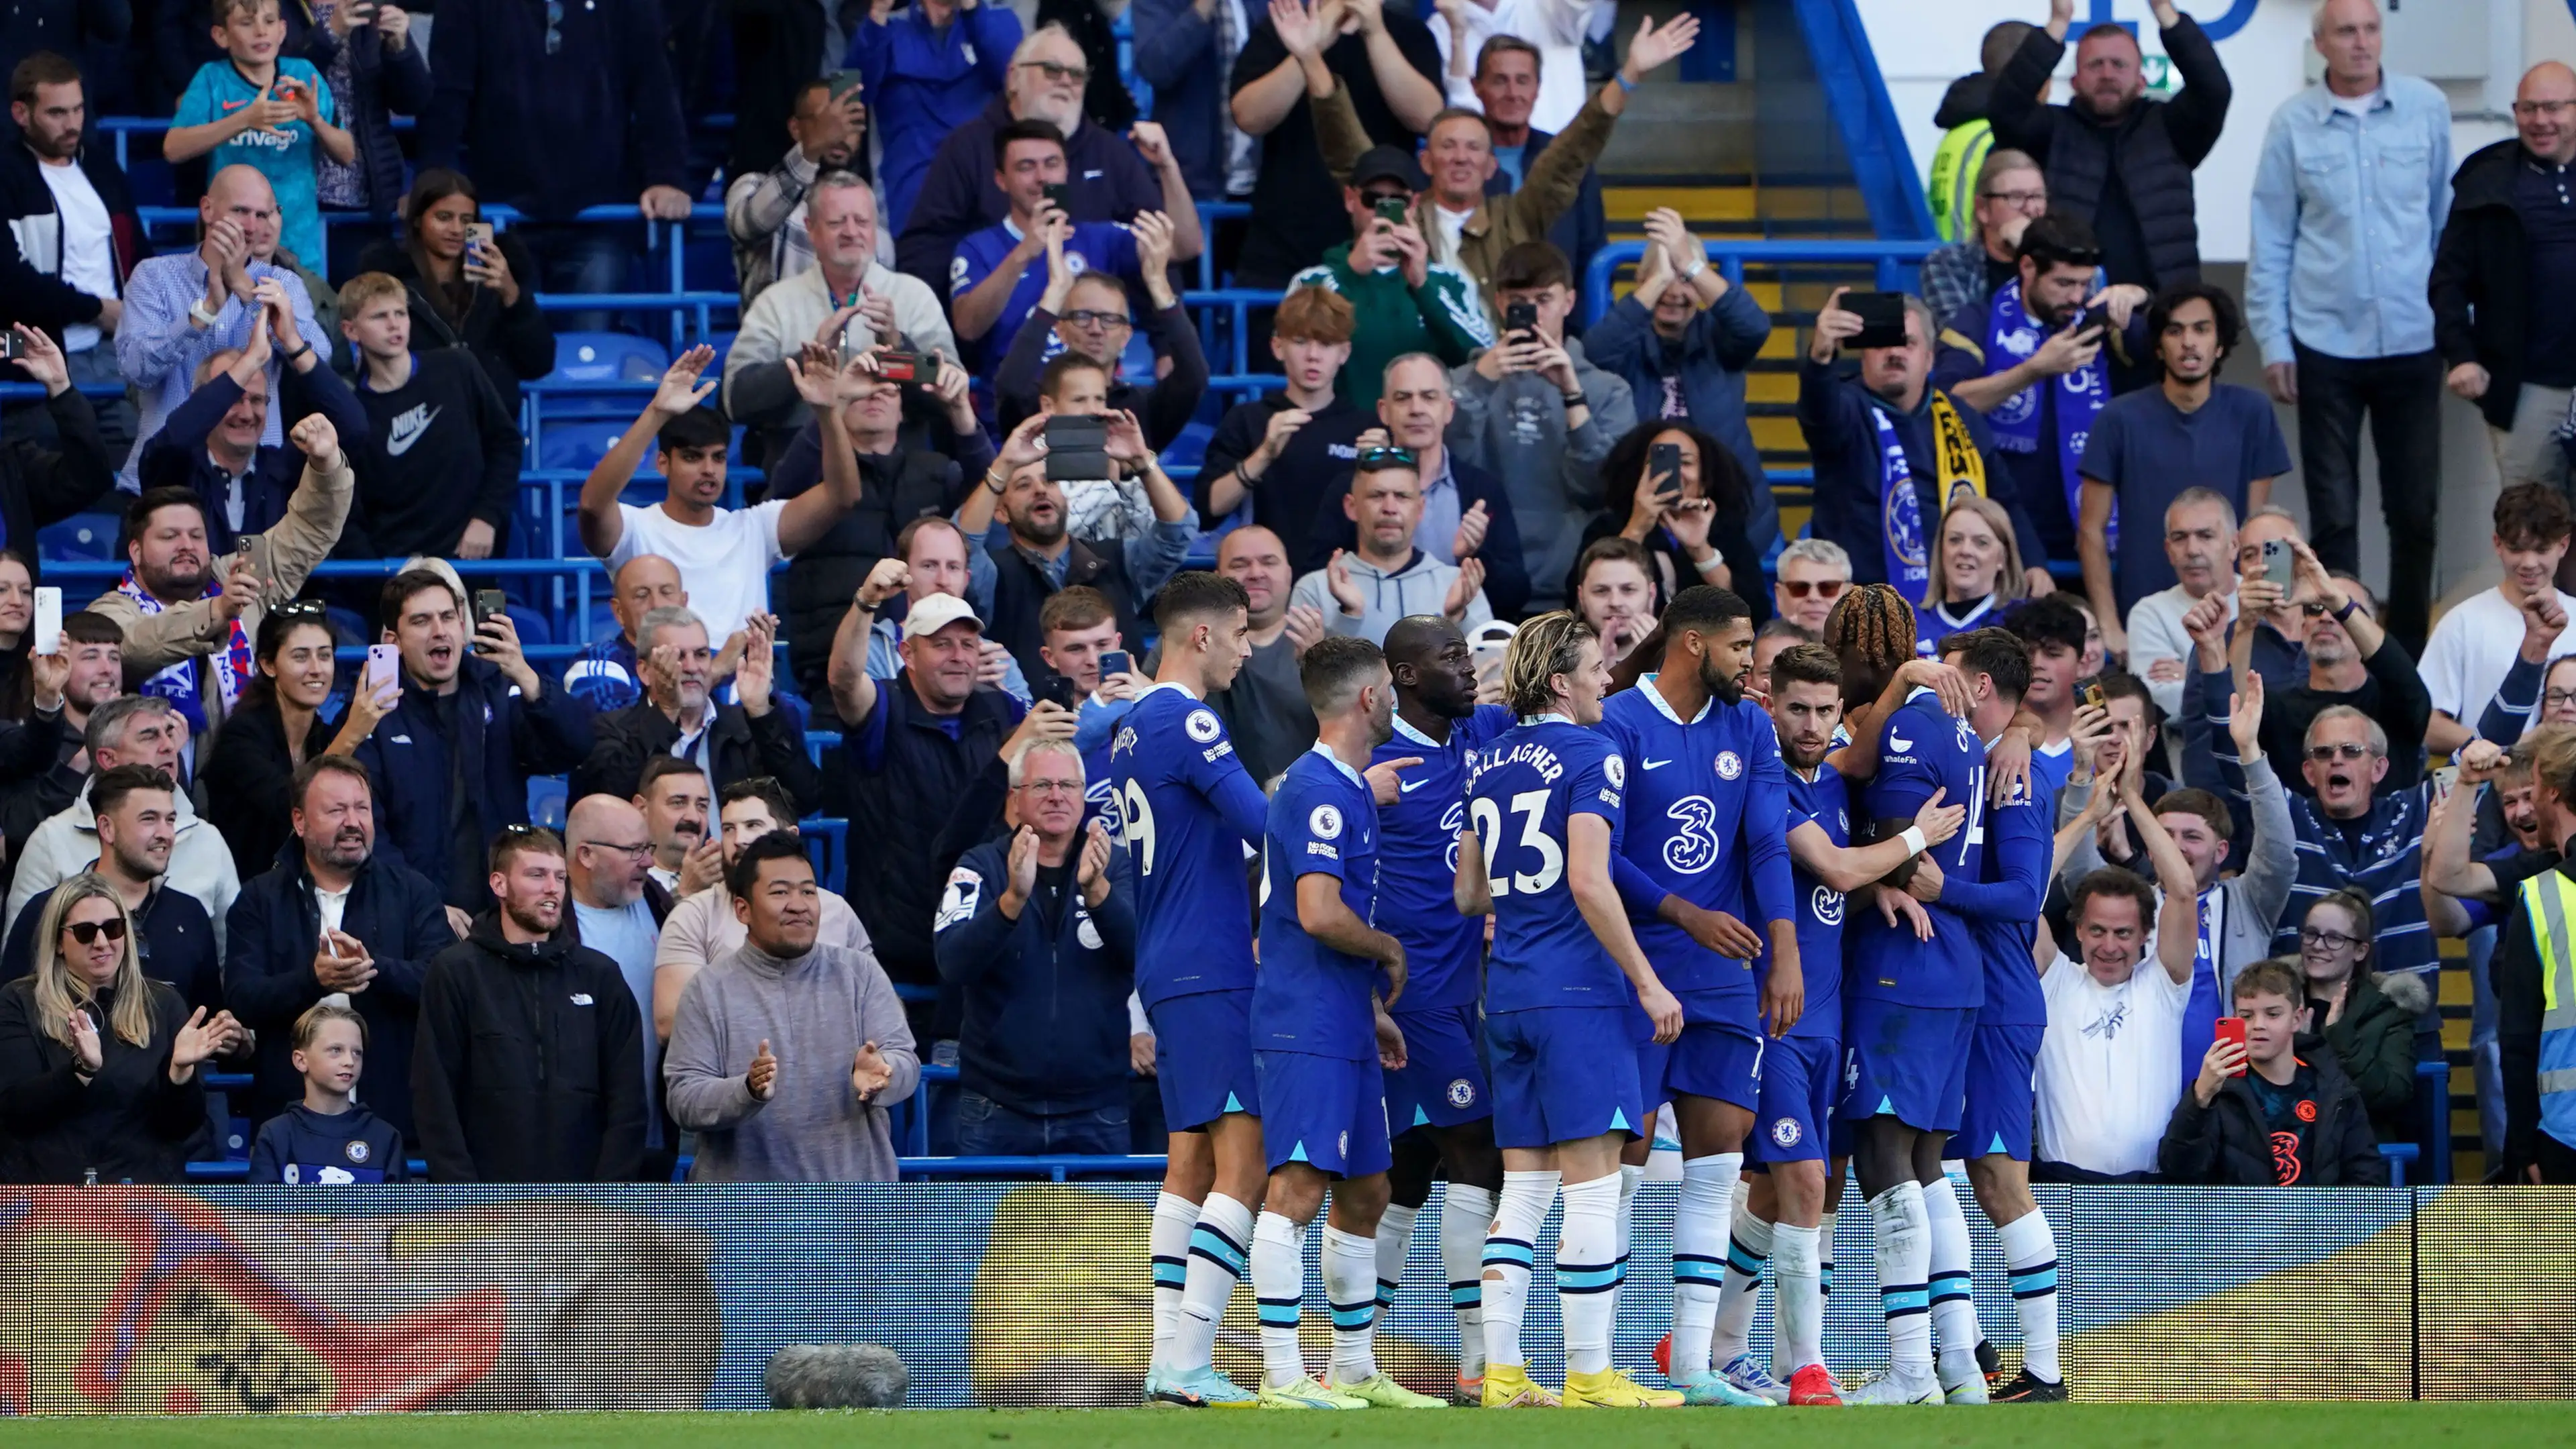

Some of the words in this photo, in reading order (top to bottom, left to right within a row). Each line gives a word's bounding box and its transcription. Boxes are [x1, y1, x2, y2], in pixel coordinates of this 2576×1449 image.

[392, 402, 428, 439] NIKE
[1464, 743, 1564, 796] GALLAGHER
[1883, 755, 1917, 765] WhaleFin
[1470, 789, 1564, 898] 23
